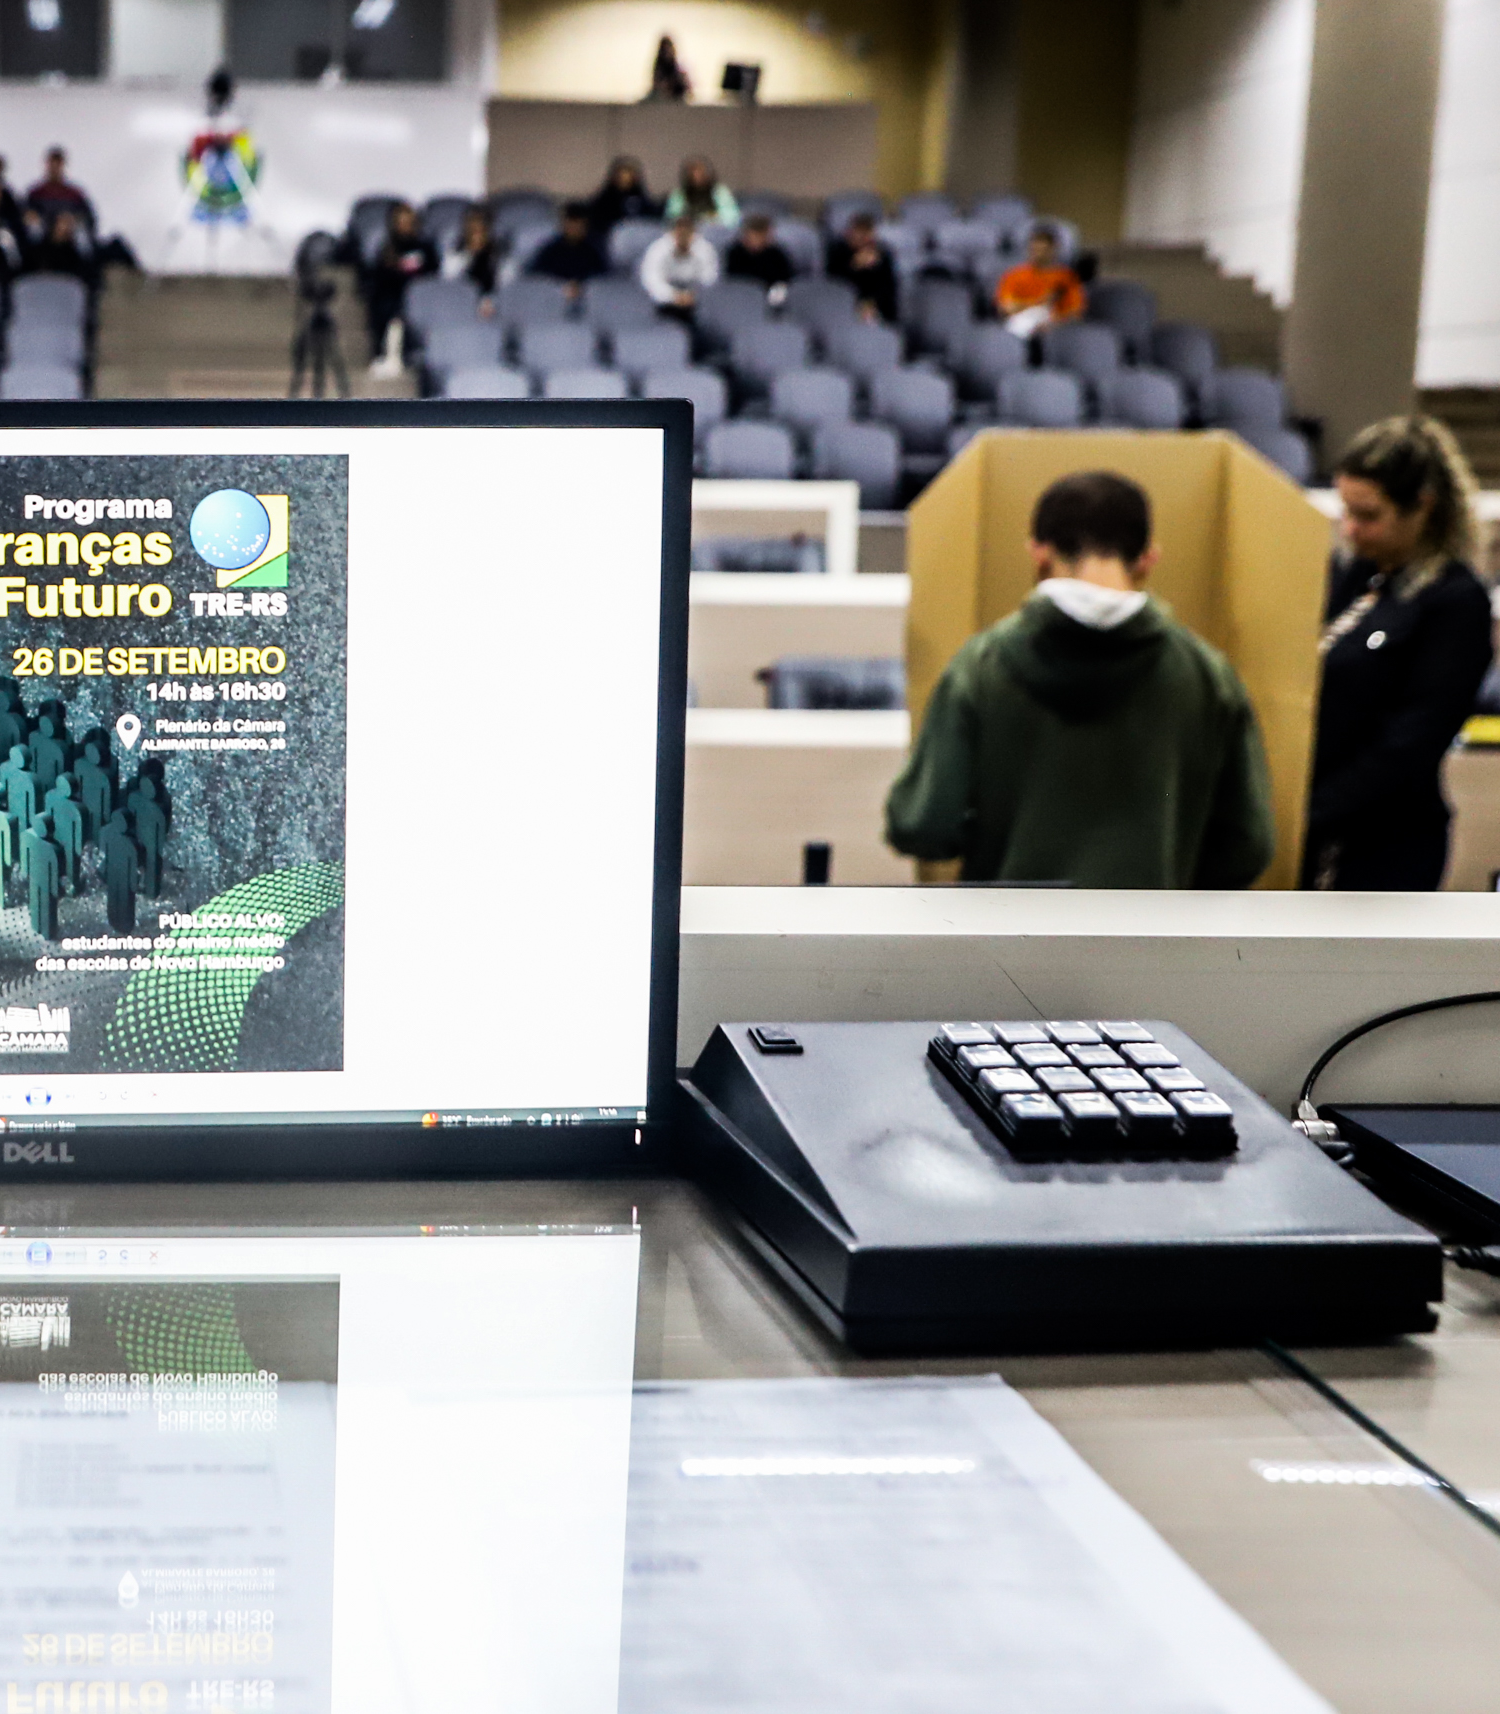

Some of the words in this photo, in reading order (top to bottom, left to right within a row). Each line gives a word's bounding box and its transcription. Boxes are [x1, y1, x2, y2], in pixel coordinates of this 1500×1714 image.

[24, 494, 172, 525] Programa
[189, 592, 288, 616] TRE-RS
[12, 648, 55, 676] 26
[59, 648, 102, 675] DE
[106, 646, 286, 676] SETEMBRO
[146, 682, 186, 701] 14h
[190, 682, 214, 701] às
[218, 681, 286, 701] 16h30
[155, 719, 210, 733] Plenário
[213, 719, 230, 733] da
[232, 718, 286, 733] Câmara
[141, 738, 210, 750] ALMIRANTE
[159, 912, 232, 929] PÚBLICO
[233, 913, 285, 929] ALVO:
[61, 934, 151, 950] estudantes
[177, 934, 231, 949] ensino
[233, 933, 285, 949] médio
[36, 956, 66, 971] das
[67, 956, 128, 971] escolas
[130, 956, 151, 971] de
[154, 956, 197, 971] Novo
[199, 954, 285, 972] Hamburgo
[3, 1141, 75, 1164] DELL
